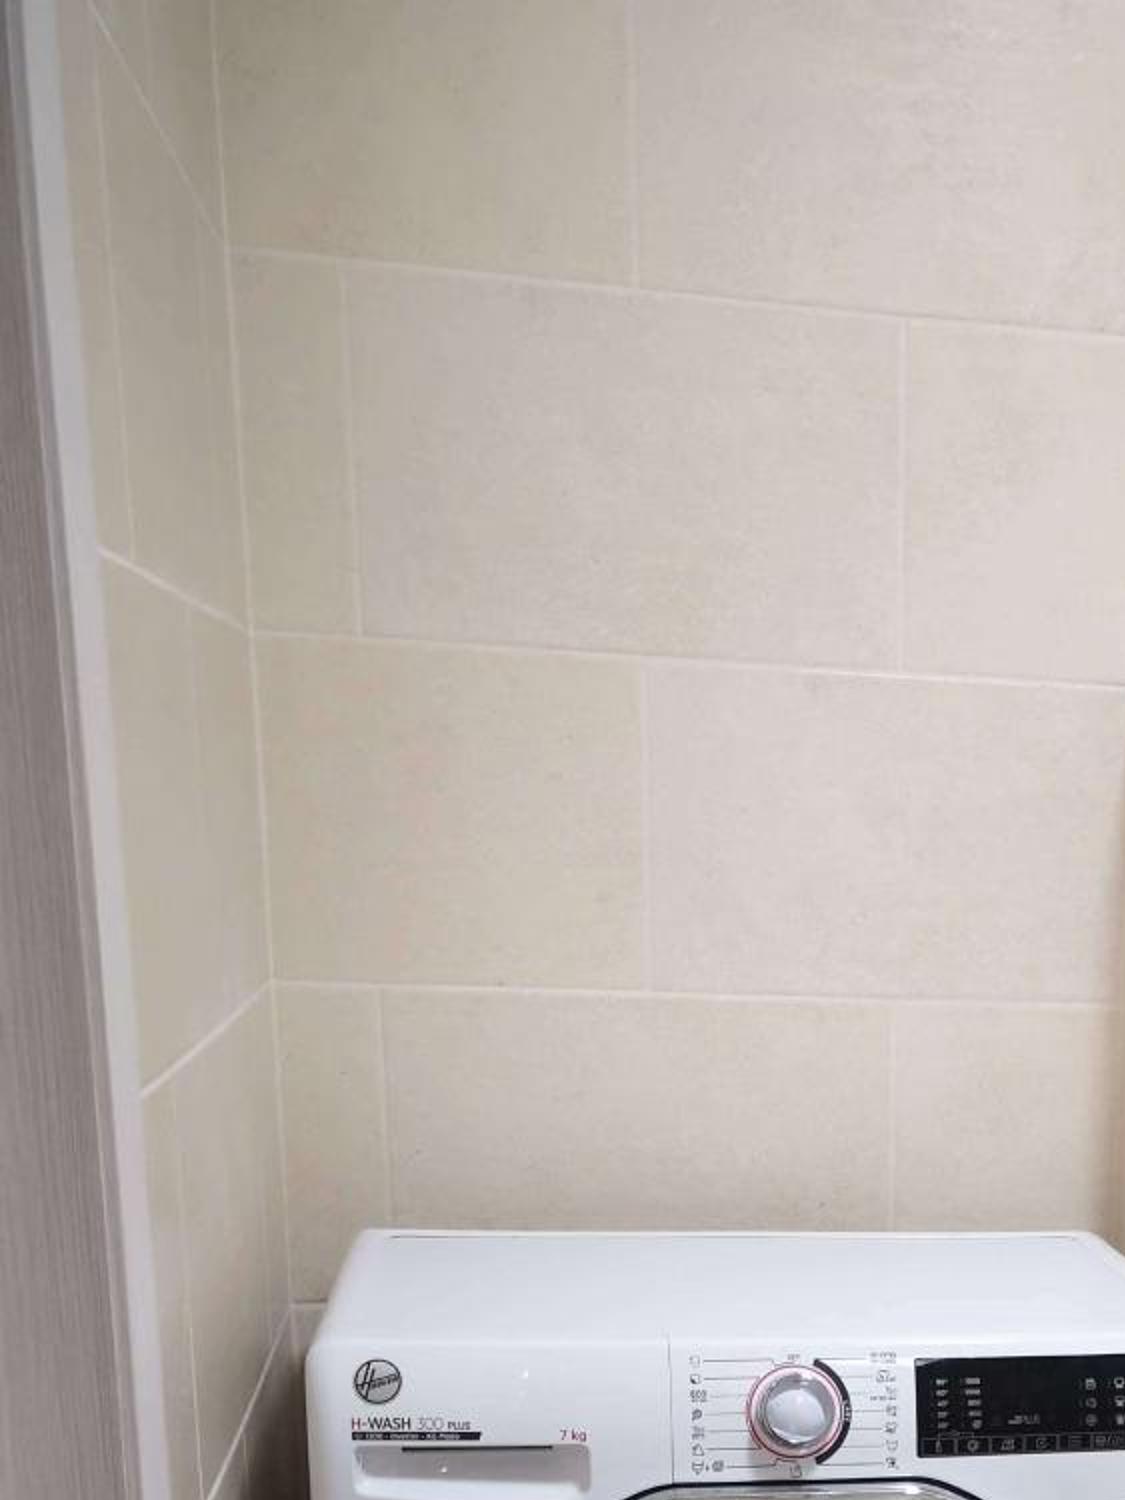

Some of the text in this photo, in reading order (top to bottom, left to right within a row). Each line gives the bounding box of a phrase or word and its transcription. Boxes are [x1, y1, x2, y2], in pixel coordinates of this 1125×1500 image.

[351, 1417, 471, 1430] H-WASH 300 PLUS
[560, 1428, 587, 1442] 7 kg
